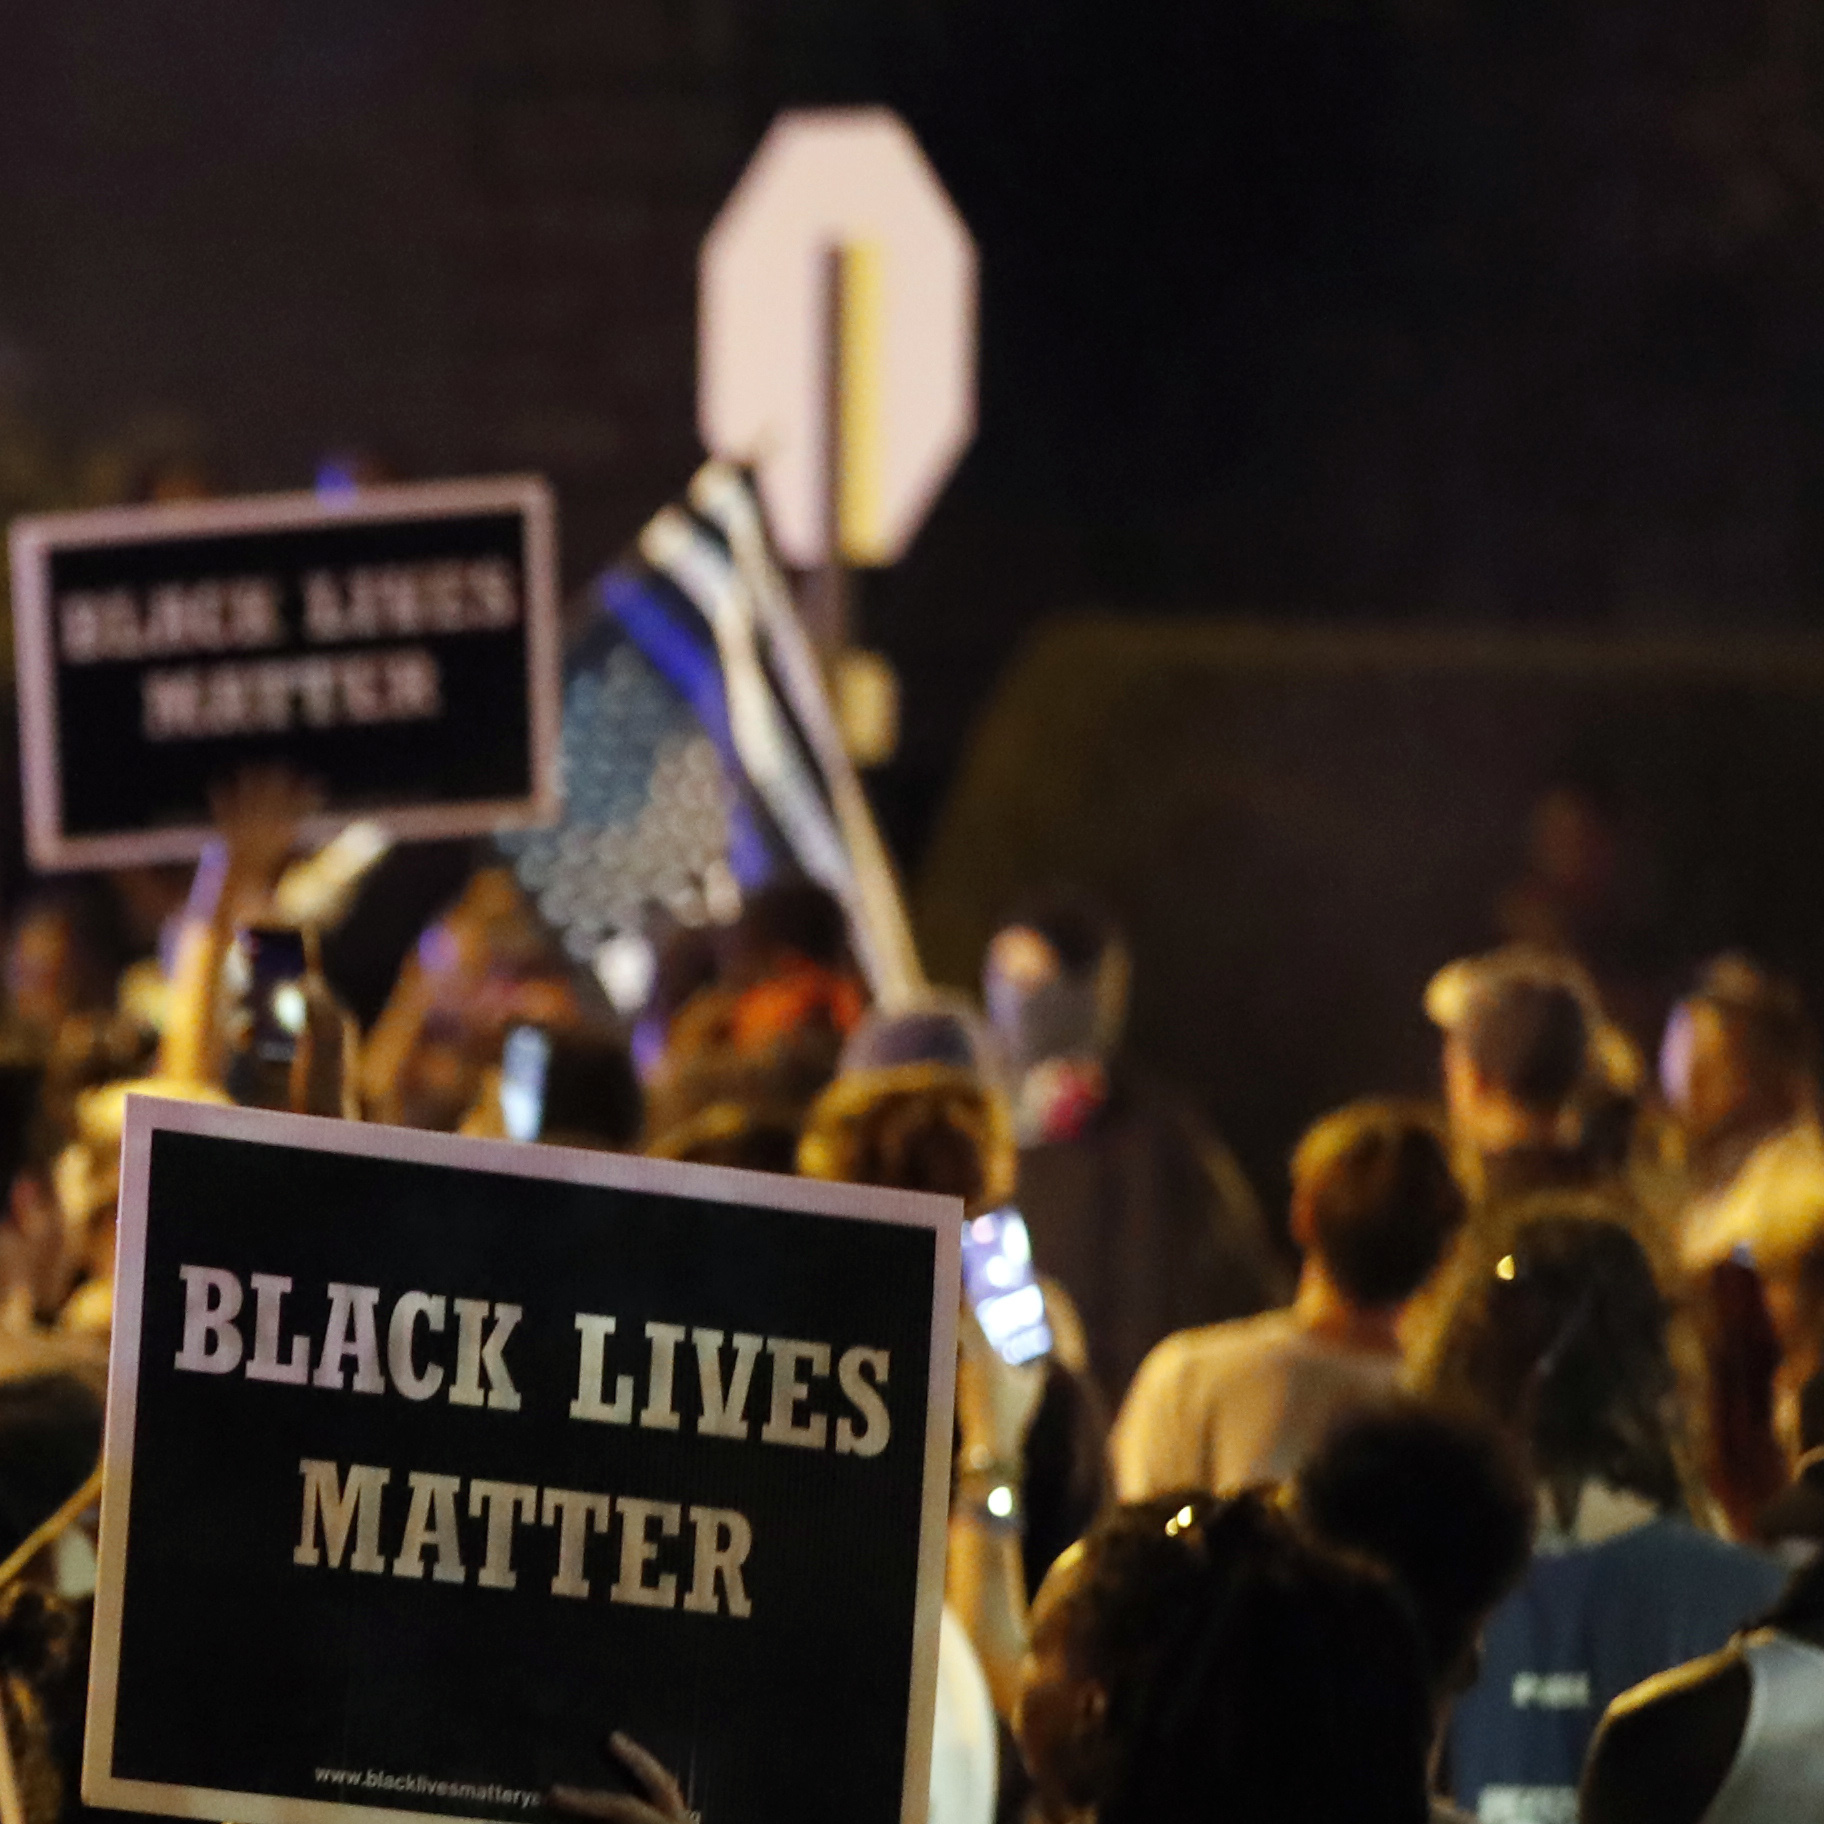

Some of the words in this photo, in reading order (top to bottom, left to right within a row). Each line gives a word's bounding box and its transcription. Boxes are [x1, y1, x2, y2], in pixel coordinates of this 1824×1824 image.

[58, 574, 279, 663] BLACK
[302, 556, 519, 638] LIVES
[142, 649, 440, 740] MATTER
[175, 1266, 522, 1411] BLACK
[569, 1313, 891, 1457] LIVES
[294, 1460, 753, 1618] MATTER
